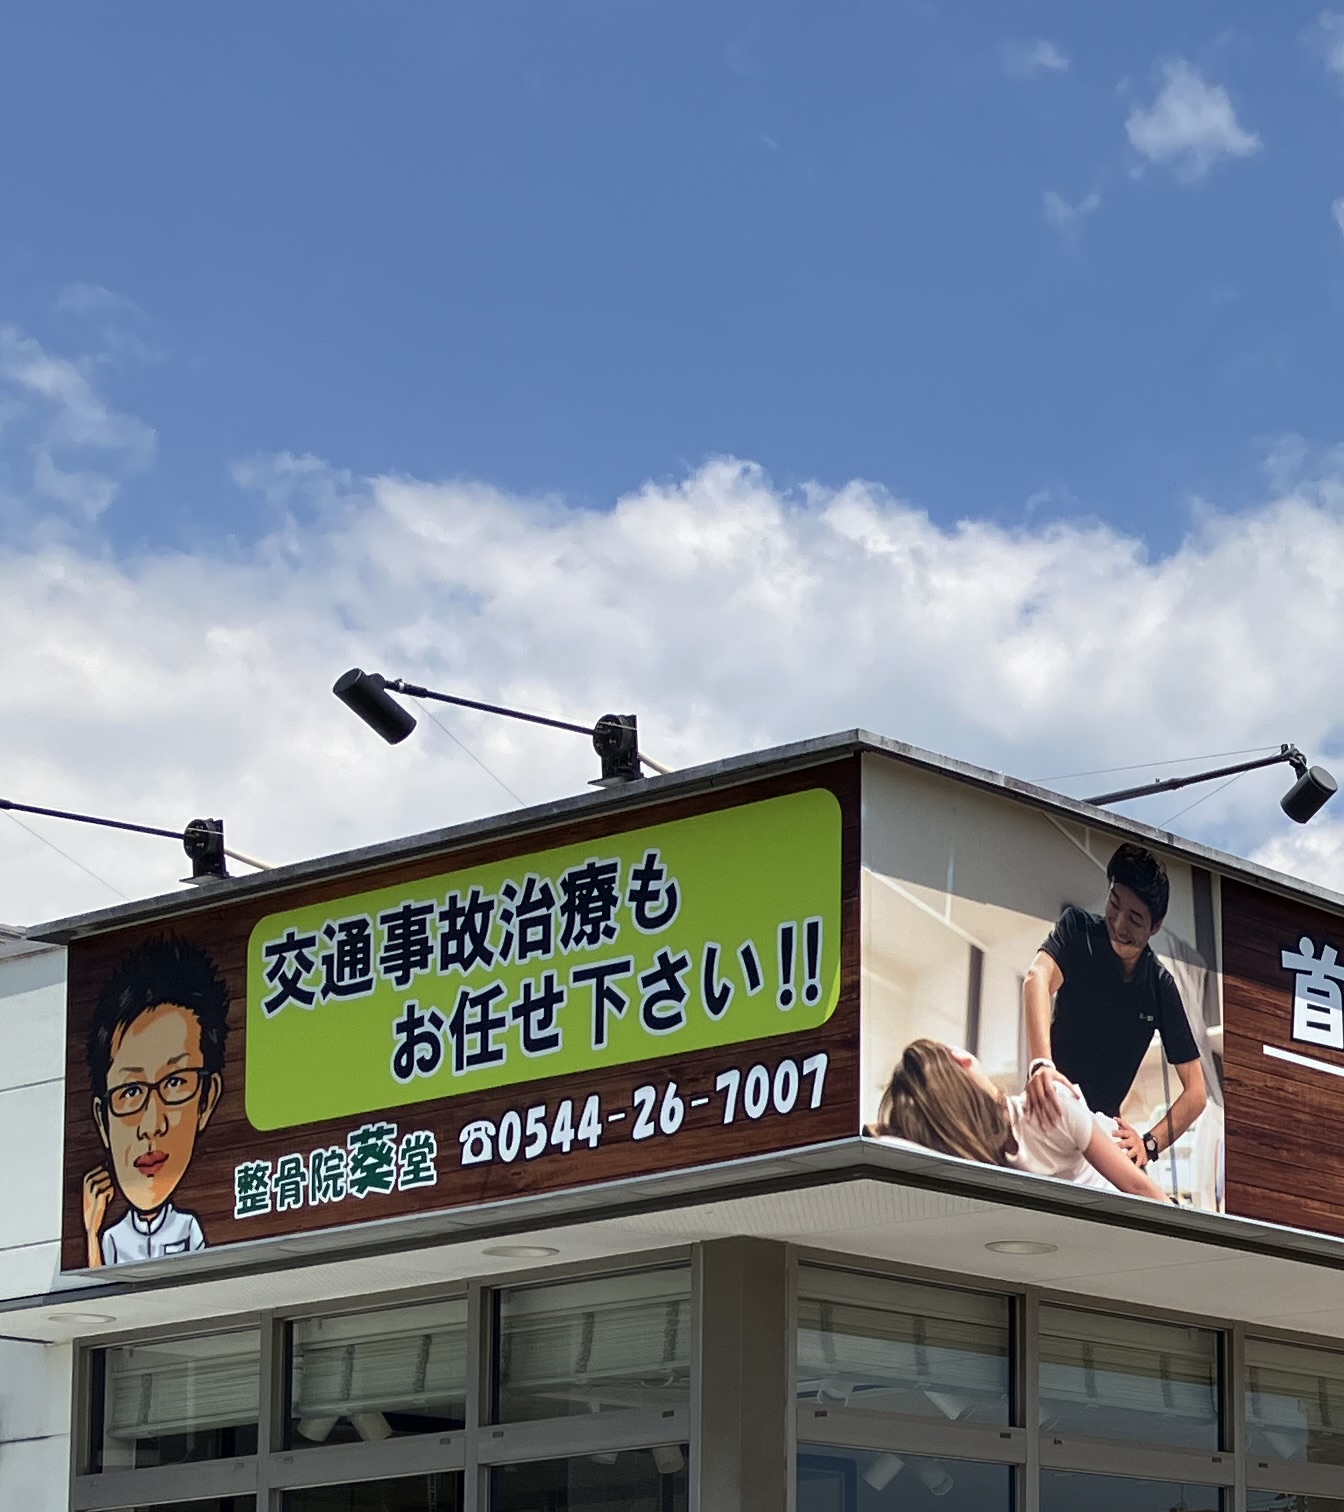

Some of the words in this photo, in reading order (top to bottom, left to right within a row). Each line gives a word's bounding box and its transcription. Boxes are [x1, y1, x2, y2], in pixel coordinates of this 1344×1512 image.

[262, 850, 681, 1015] 交通事故治療も
[233, 1123, 438, 1219] 整骨院葵堂
